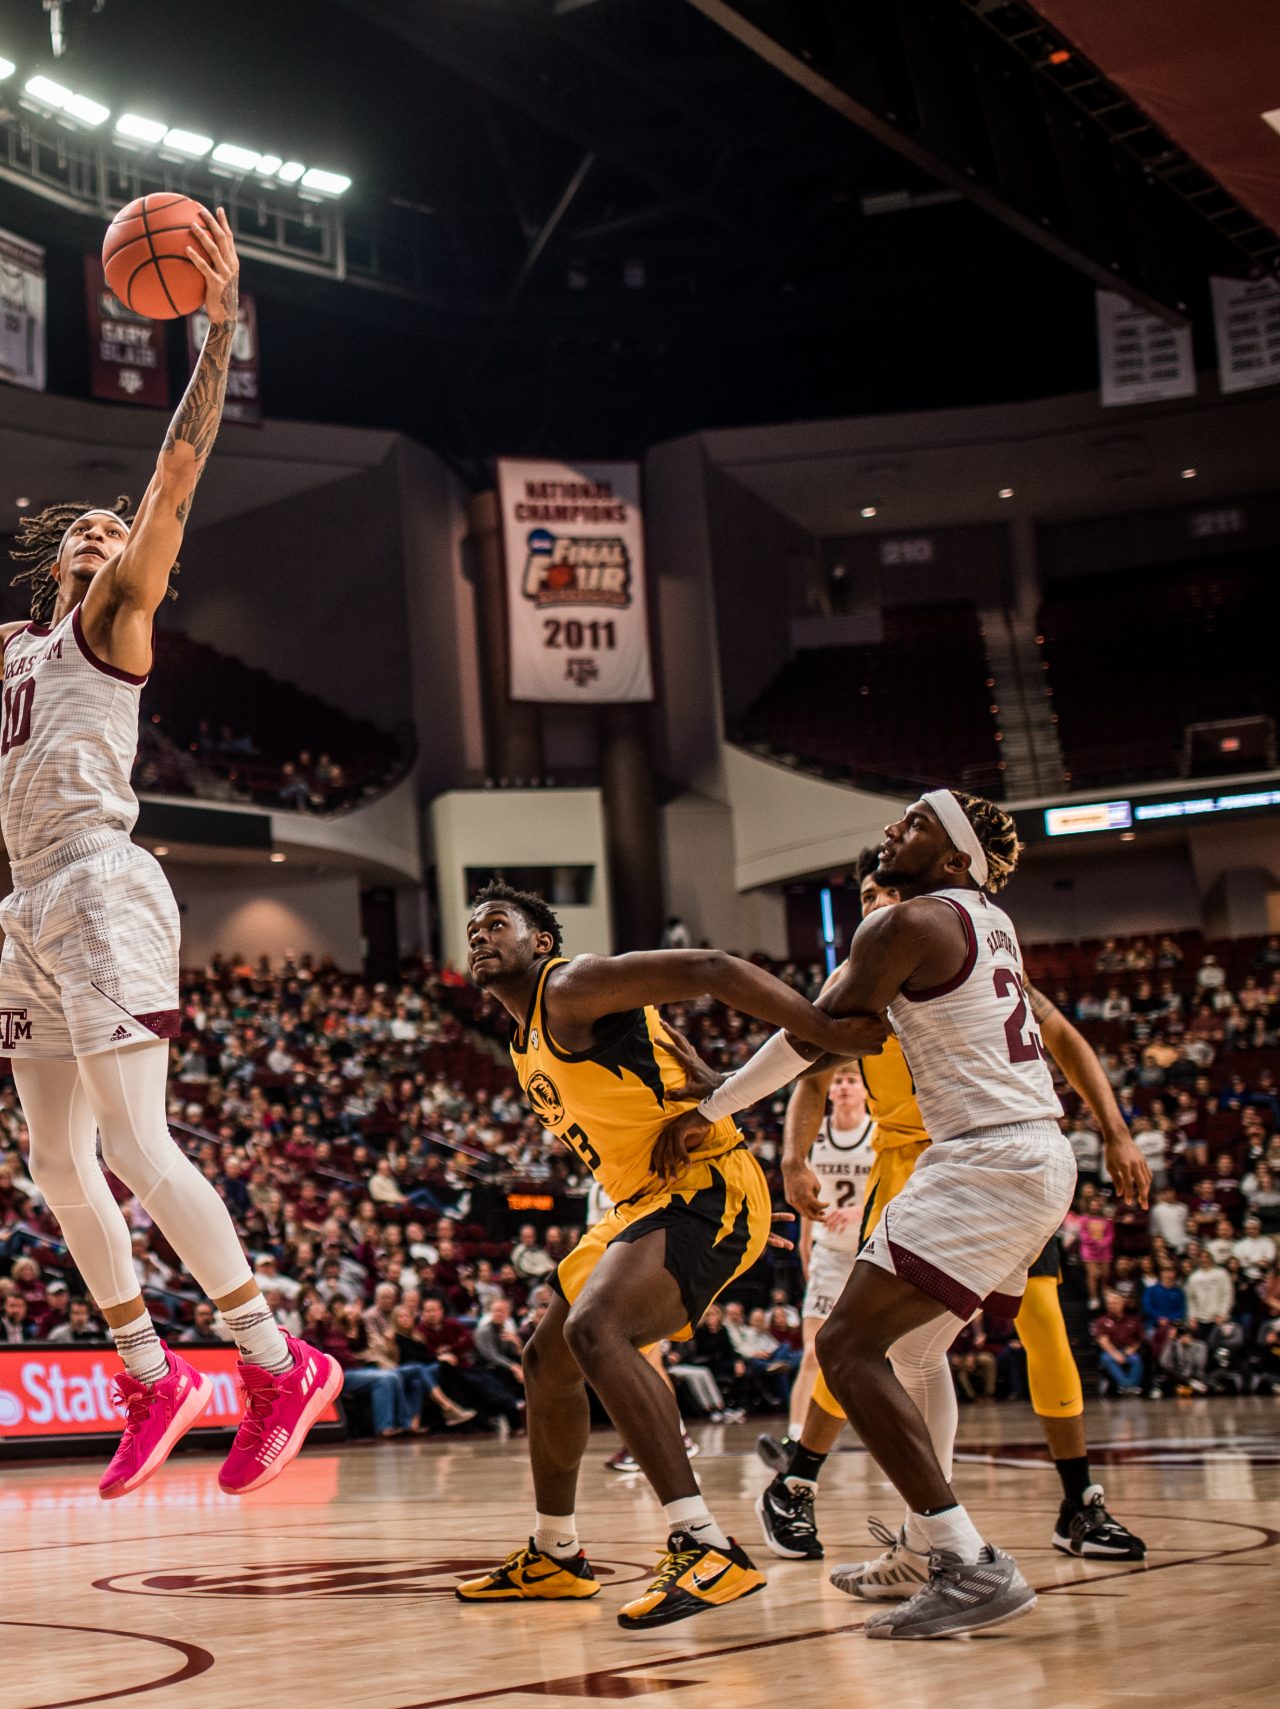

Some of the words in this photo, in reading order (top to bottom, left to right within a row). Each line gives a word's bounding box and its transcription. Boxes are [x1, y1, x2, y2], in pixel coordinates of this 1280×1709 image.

[524, 482, 612, 499] NATIONAL
[515, 504, 627, 523] CHAMPIONS
[543, 620, 615, 650] 2011
[110, 1032, 132, 1042] adidas
[815, 1164, 850, 1176] TEXAS
